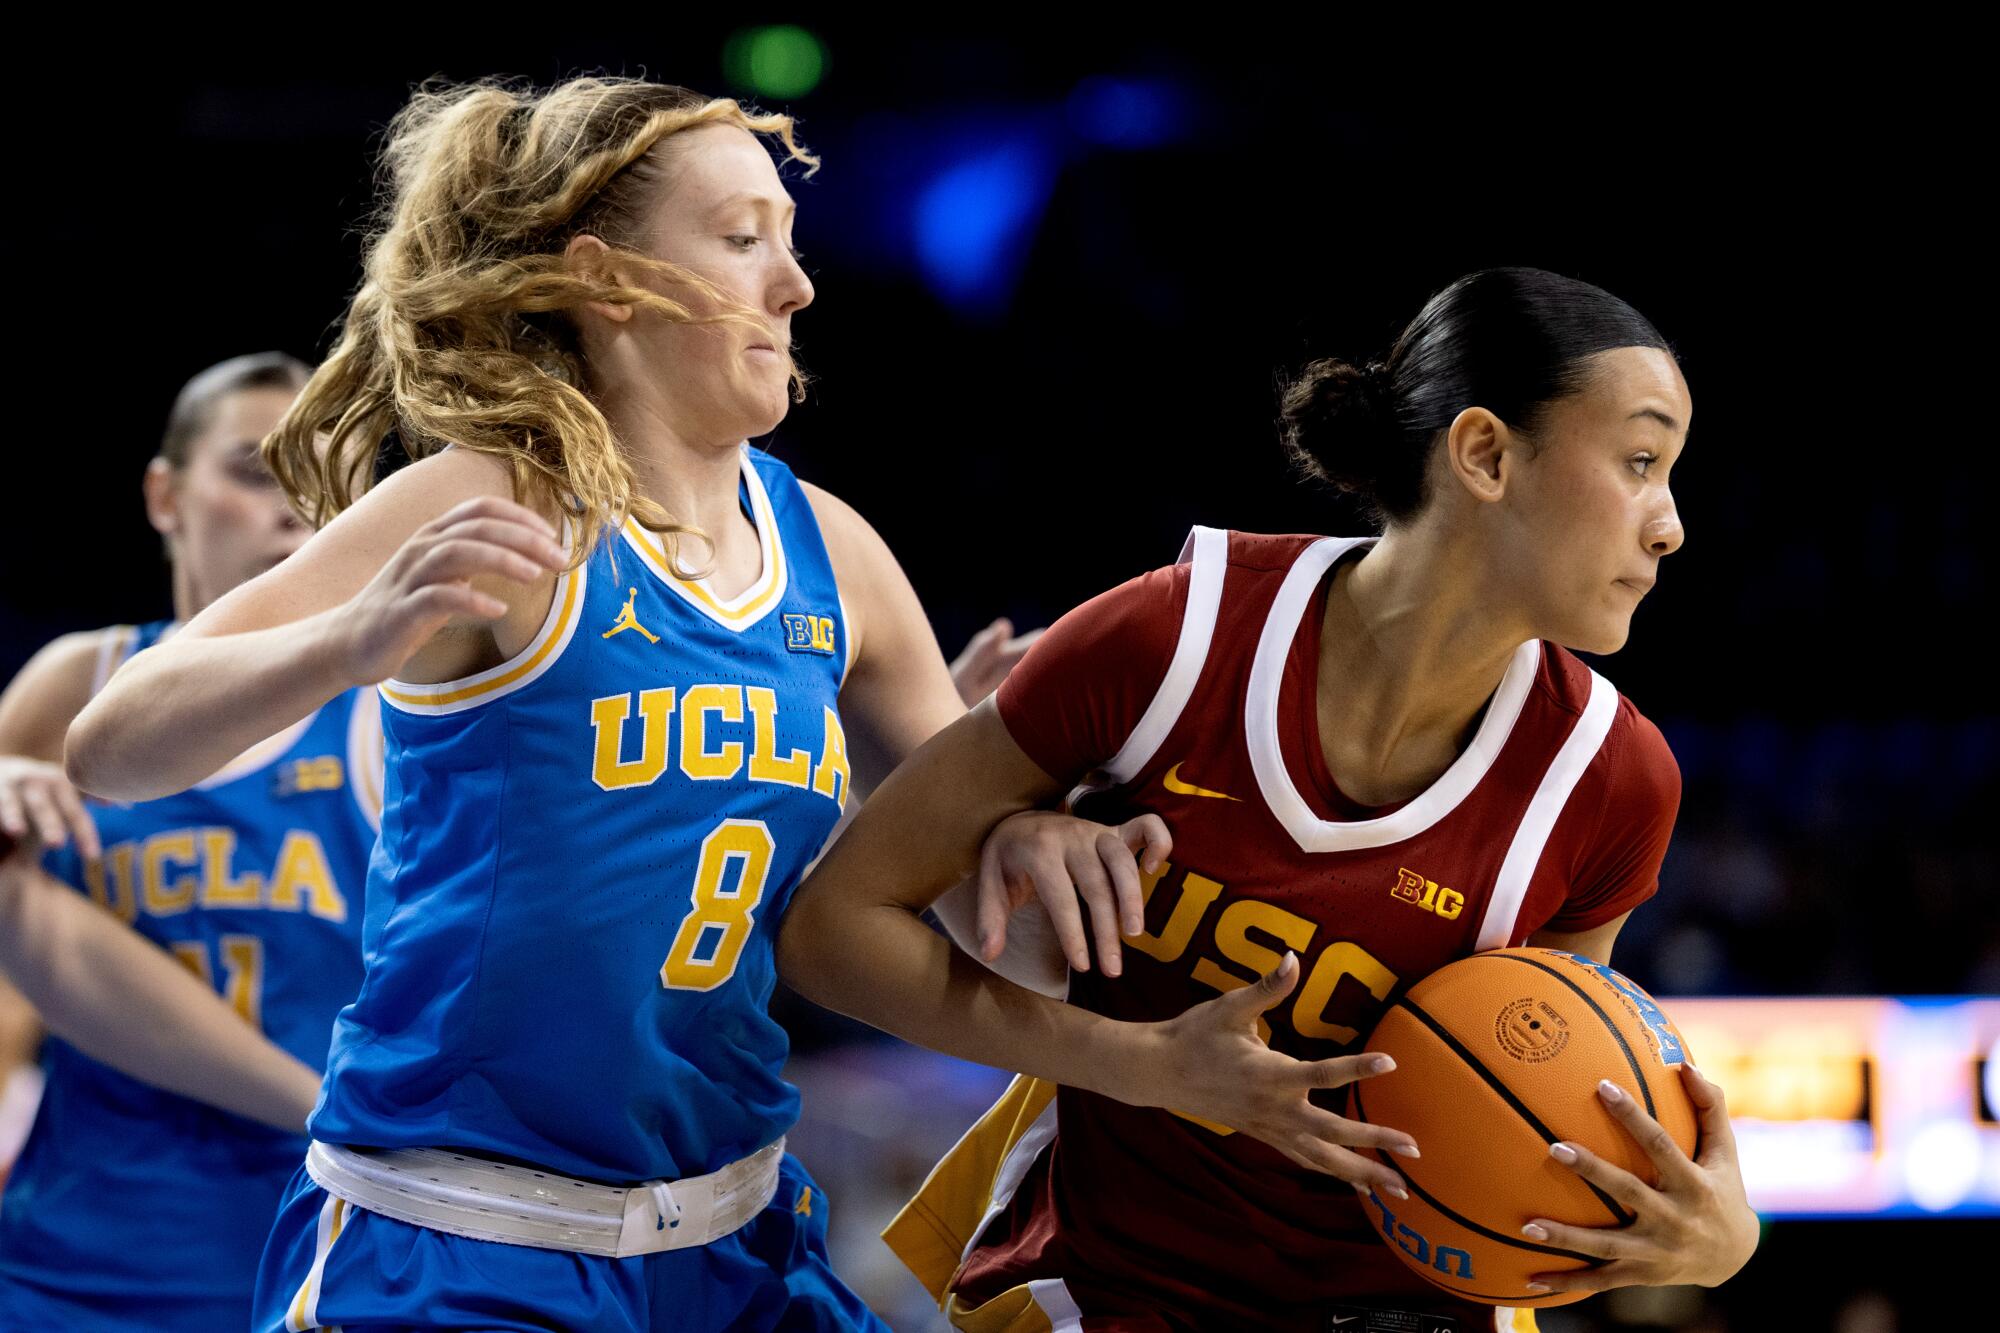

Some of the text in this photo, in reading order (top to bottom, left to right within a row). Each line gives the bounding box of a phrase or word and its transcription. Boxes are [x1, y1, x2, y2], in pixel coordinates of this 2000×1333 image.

[590, 683, 851, 815] UCLA
[85, 826, 347, 924] UCLA
[659, 817, 776, 993] 8
[1121, 860, 1399, 1046] USC
